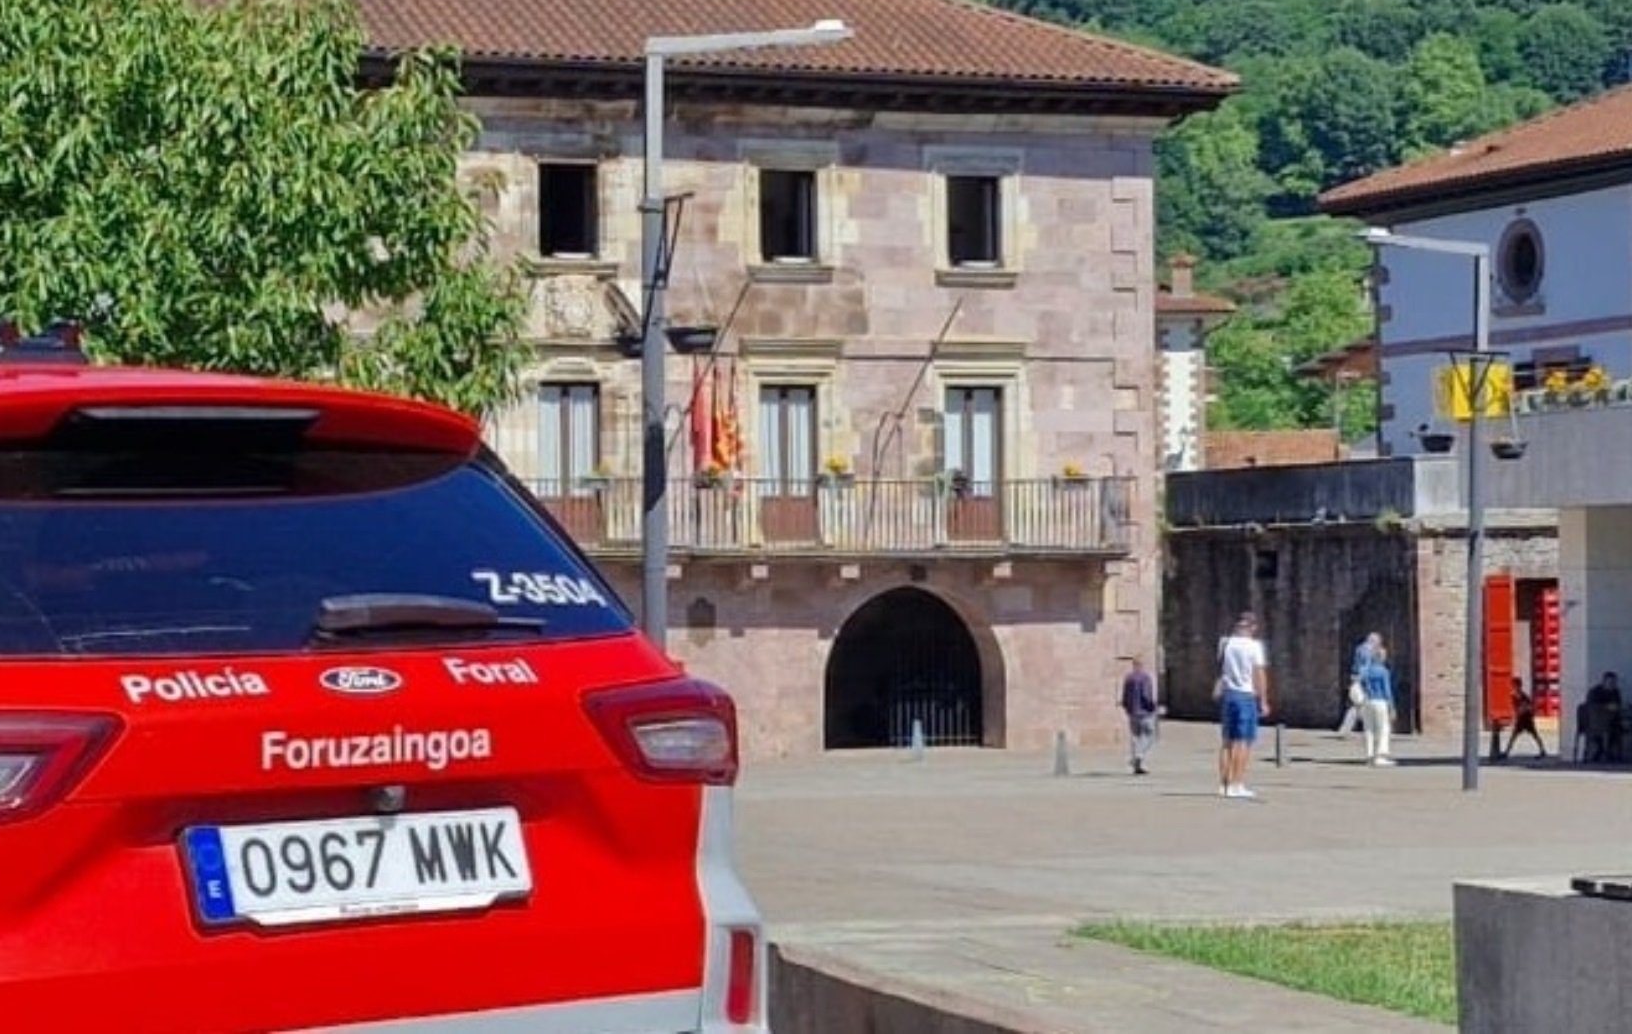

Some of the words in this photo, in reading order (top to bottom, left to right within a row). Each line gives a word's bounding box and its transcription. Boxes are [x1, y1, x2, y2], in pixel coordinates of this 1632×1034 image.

[471, 571, 608, 608] Z-3504
[120, 666, 270, 704] Policía
[444, 658, 538, 685] Foral
[261, 725, 491, 770] Foruzaingoa
[240, 830, 387, 897] 0967
[408, 821, 518, 884] MWK
[208, 879, 223, 899] E
